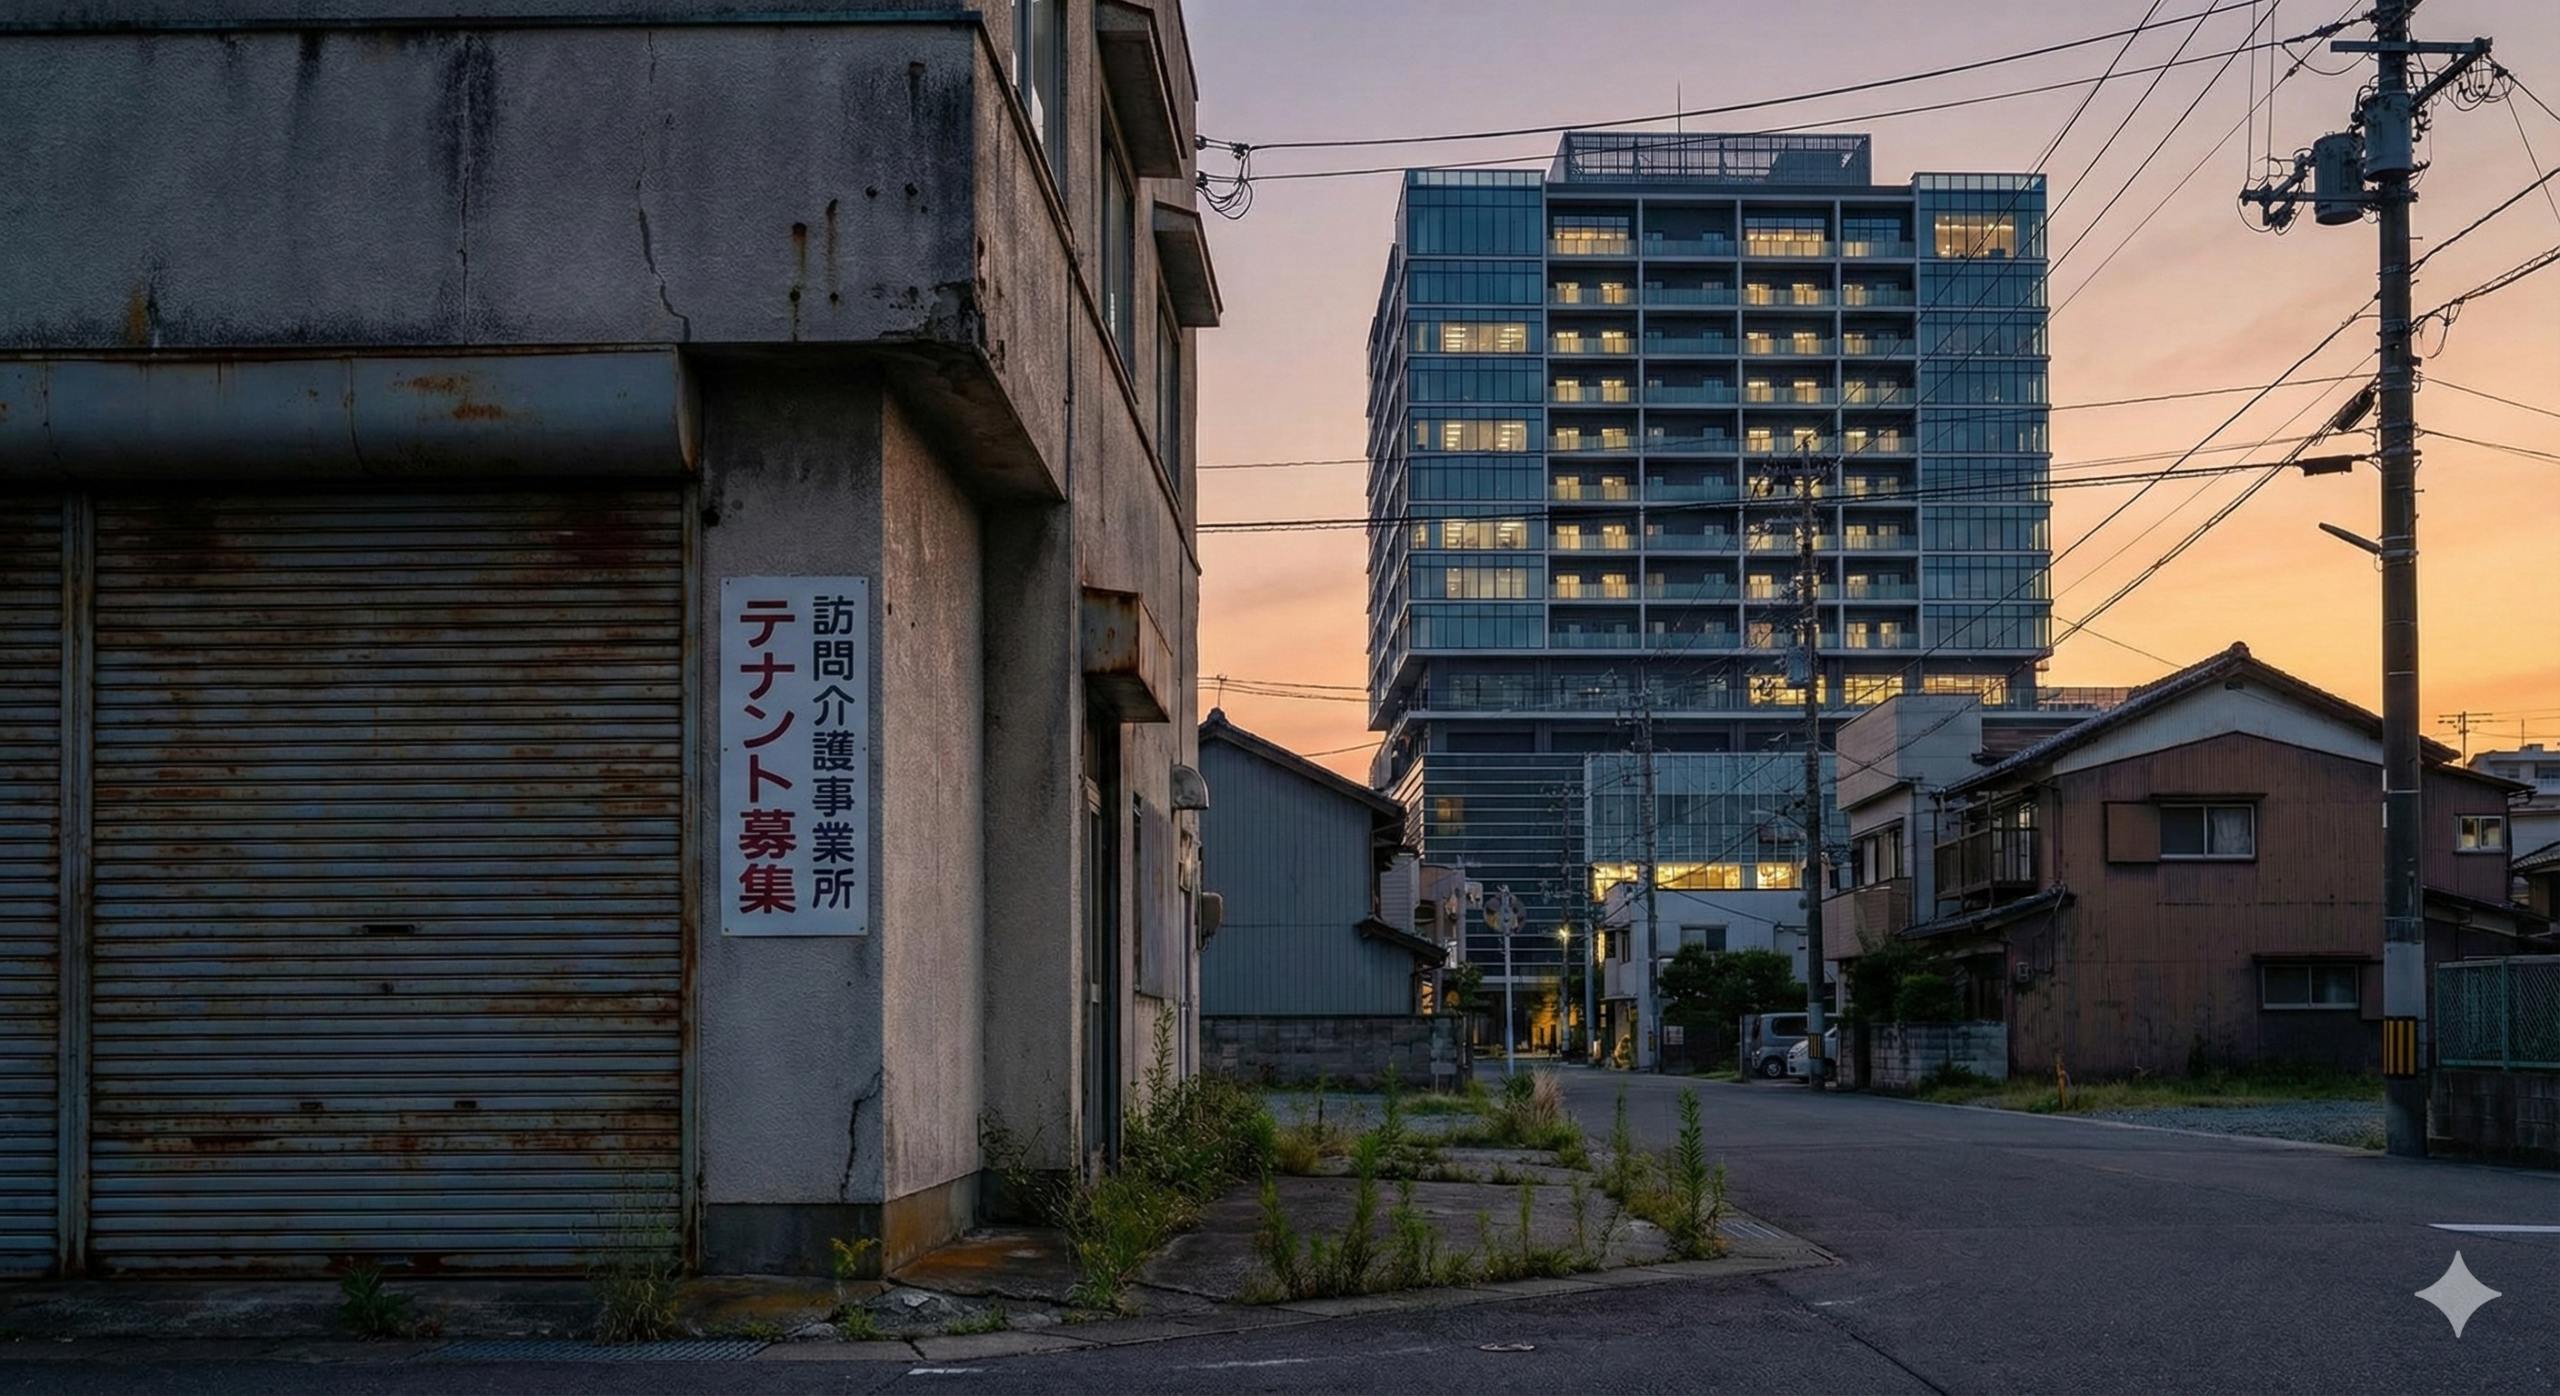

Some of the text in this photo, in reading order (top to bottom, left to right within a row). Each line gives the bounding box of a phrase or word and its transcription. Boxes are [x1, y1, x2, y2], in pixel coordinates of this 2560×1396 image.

[738, 600, 797, 914] テナント募集
[812, 595, 855, 909] 訪問介護事業所
